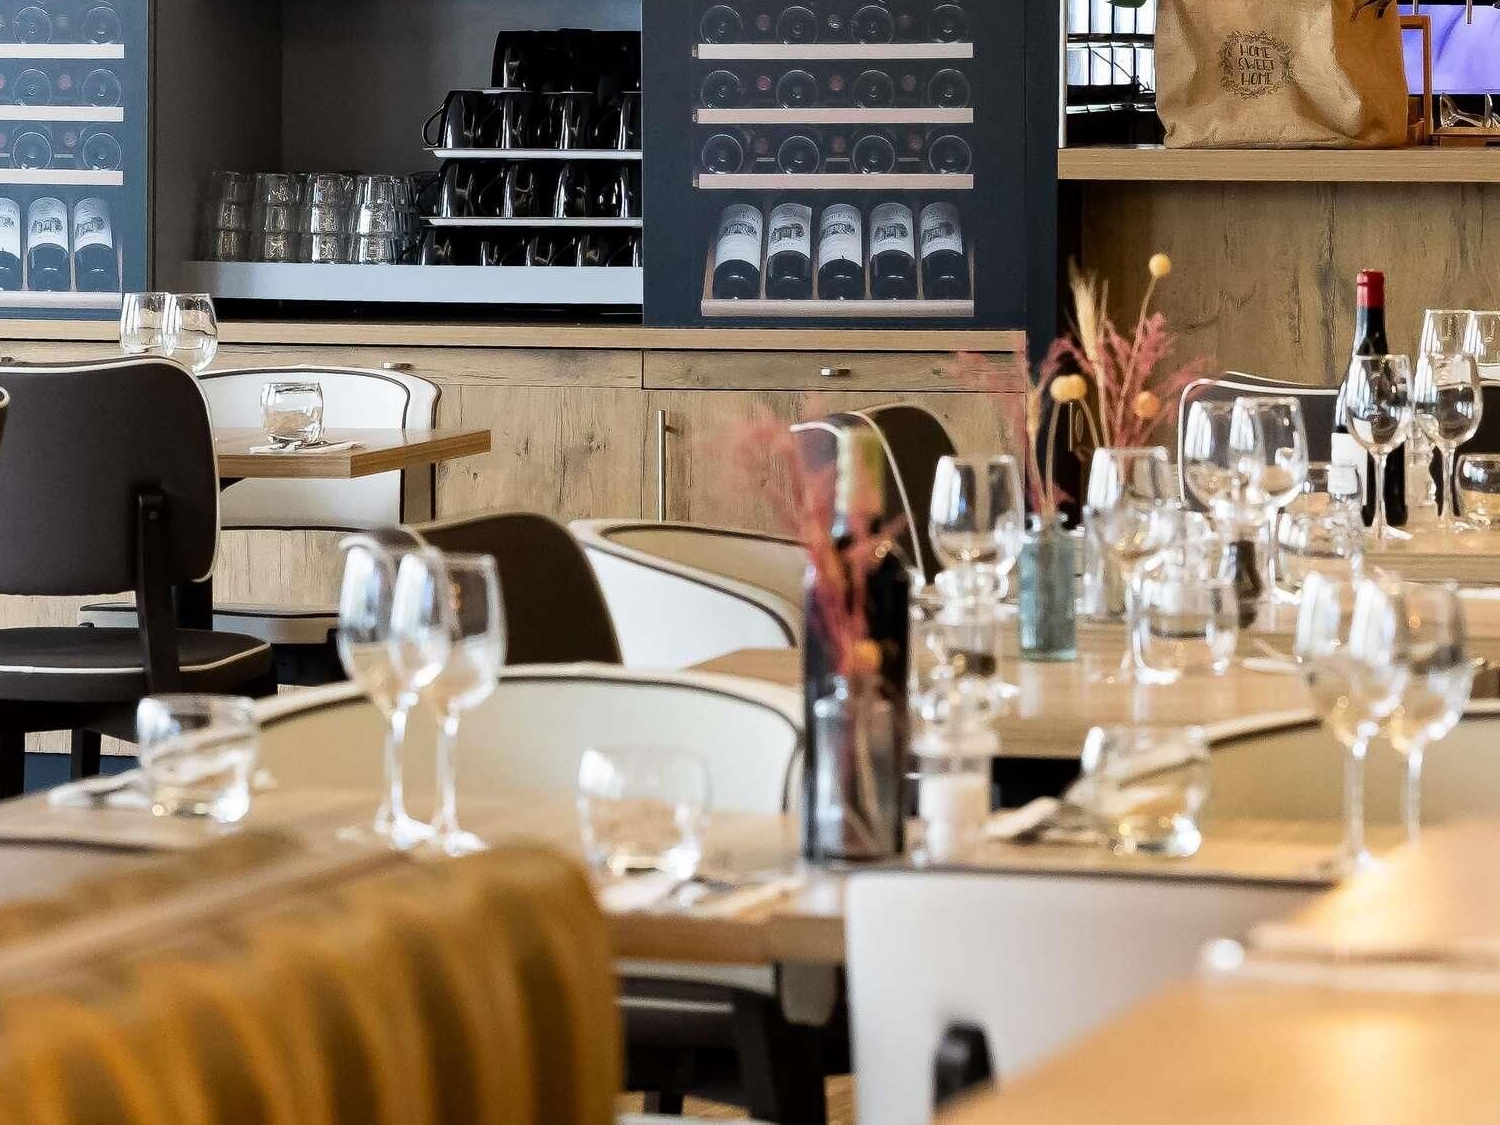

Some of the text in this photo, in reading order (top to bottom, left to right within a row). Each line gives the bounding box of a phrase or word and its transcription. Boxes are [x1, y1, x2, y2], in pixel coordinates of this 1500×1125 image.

[1239, 43, 1271, 59] HOME
[1238, 57, 1275, 71] SWEET
[1241, 72, 1273, 86] HOME
